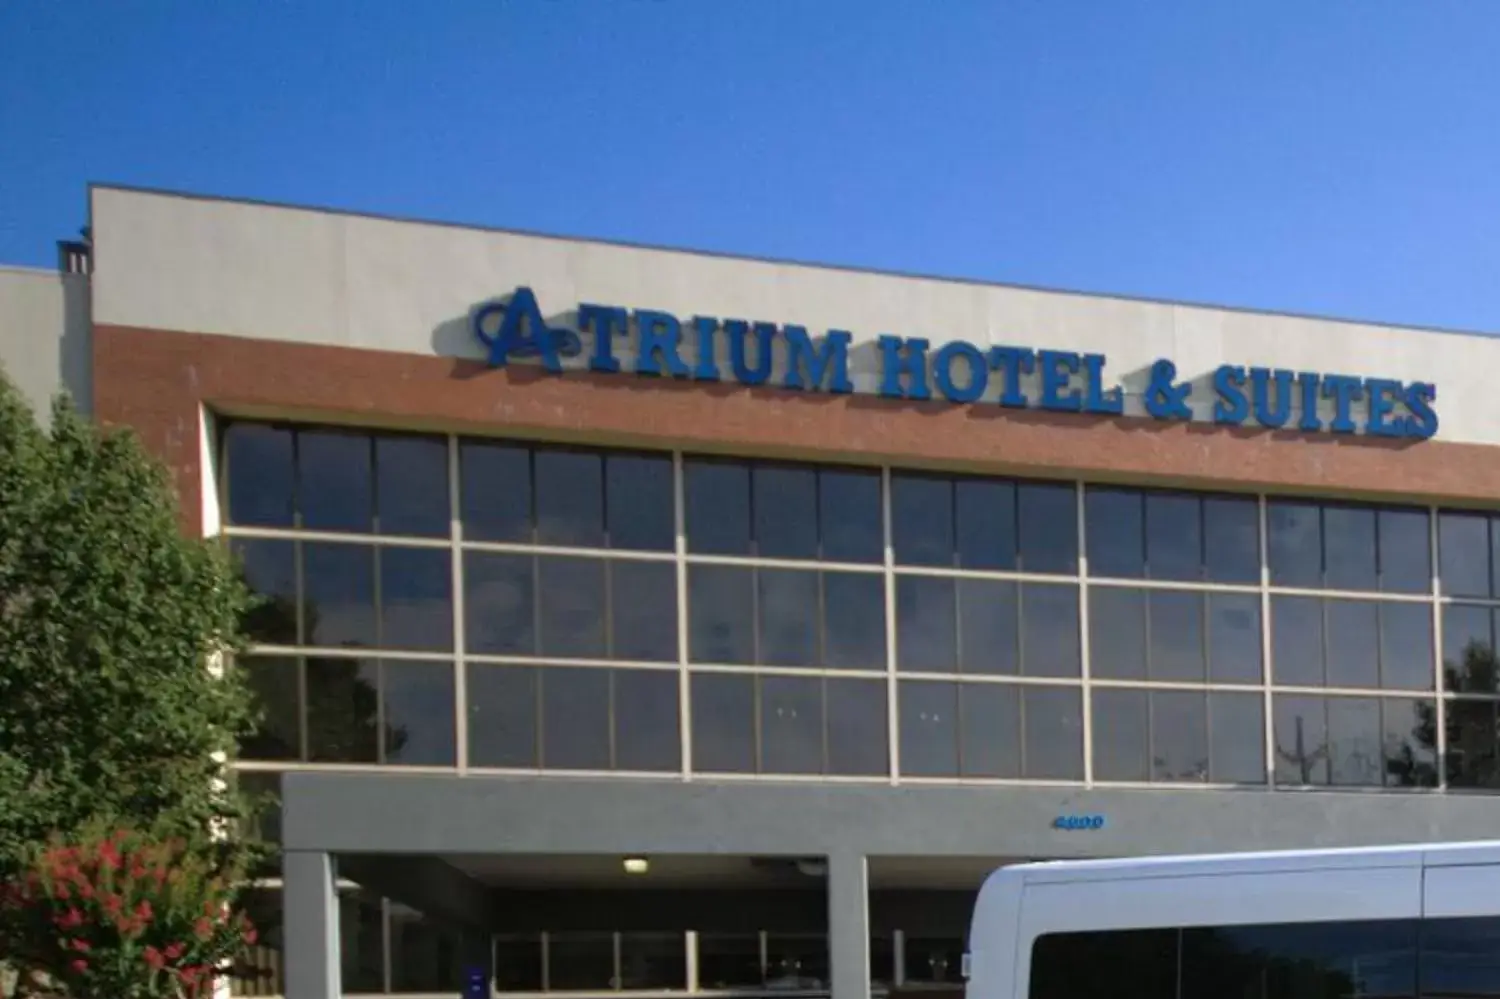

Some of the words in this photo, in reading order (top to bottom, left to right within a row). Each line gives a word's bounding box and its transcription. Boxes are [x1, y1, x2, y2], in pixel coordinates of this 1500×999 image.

[473, 286, 852, 394] ATRIUM
[878, 333, 1124, 416] HOTEL
[1145, 359, 1194, 421] &
[1213, 364, 1440, 440] SUITES
